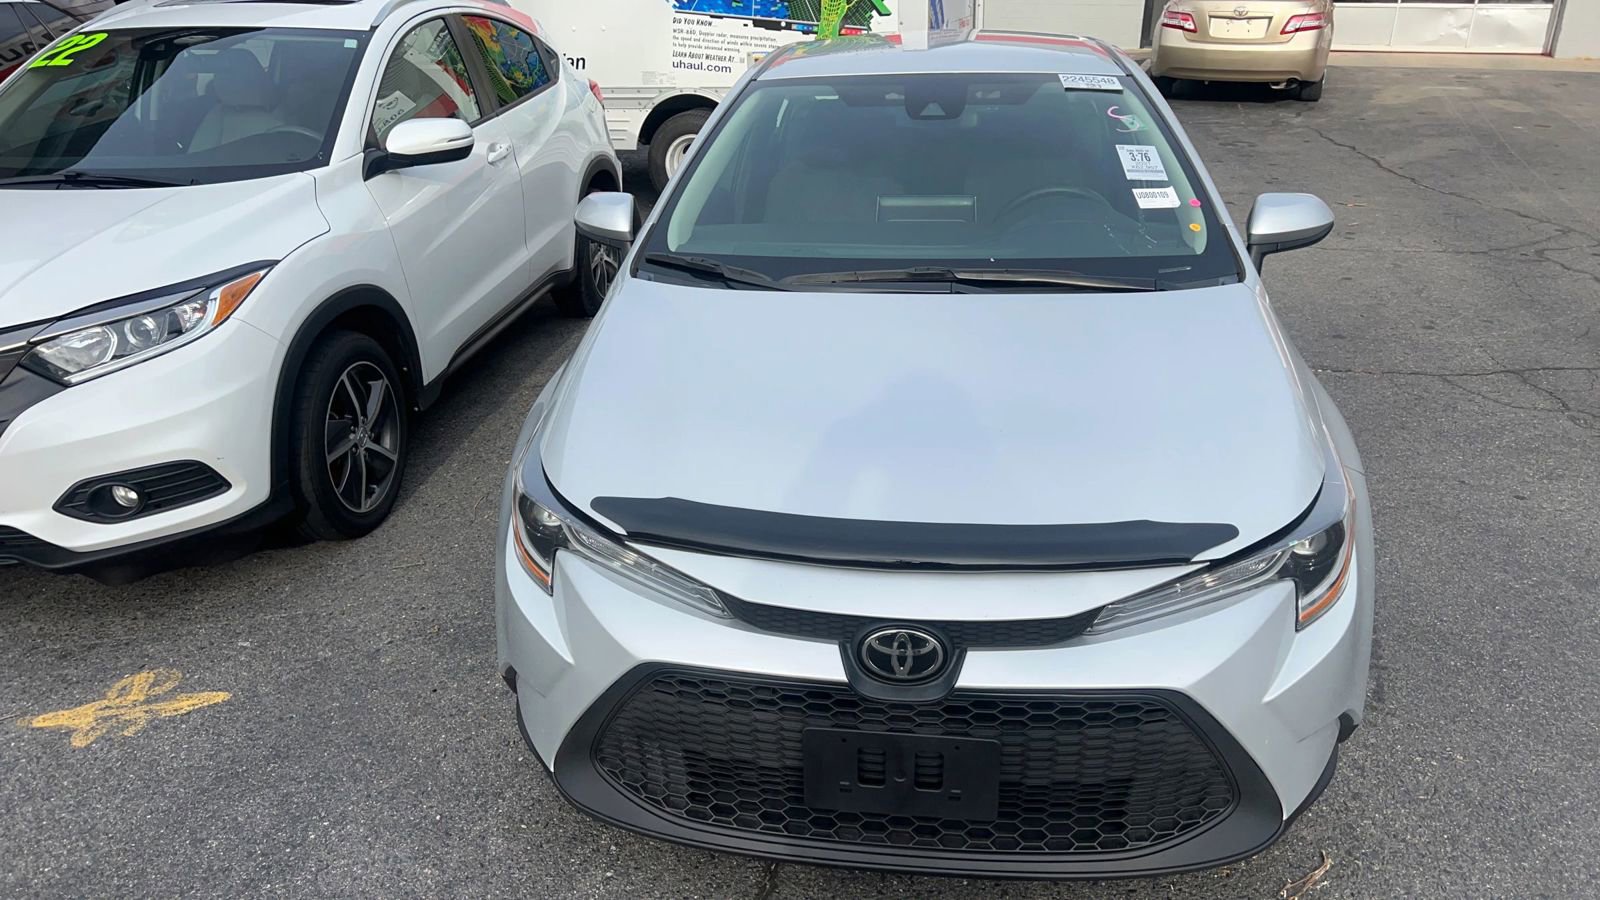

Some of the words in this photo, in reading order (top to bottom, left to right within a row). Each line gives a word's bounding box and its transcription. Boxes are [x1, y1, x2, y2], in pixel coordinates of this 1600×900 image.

[27, 33, 109, 69] 22
[688, 52, 704, 60] ABOUT
[705, 53, 727, 62] WEATHER
[672, 60, 732, 73] uhaul.com
